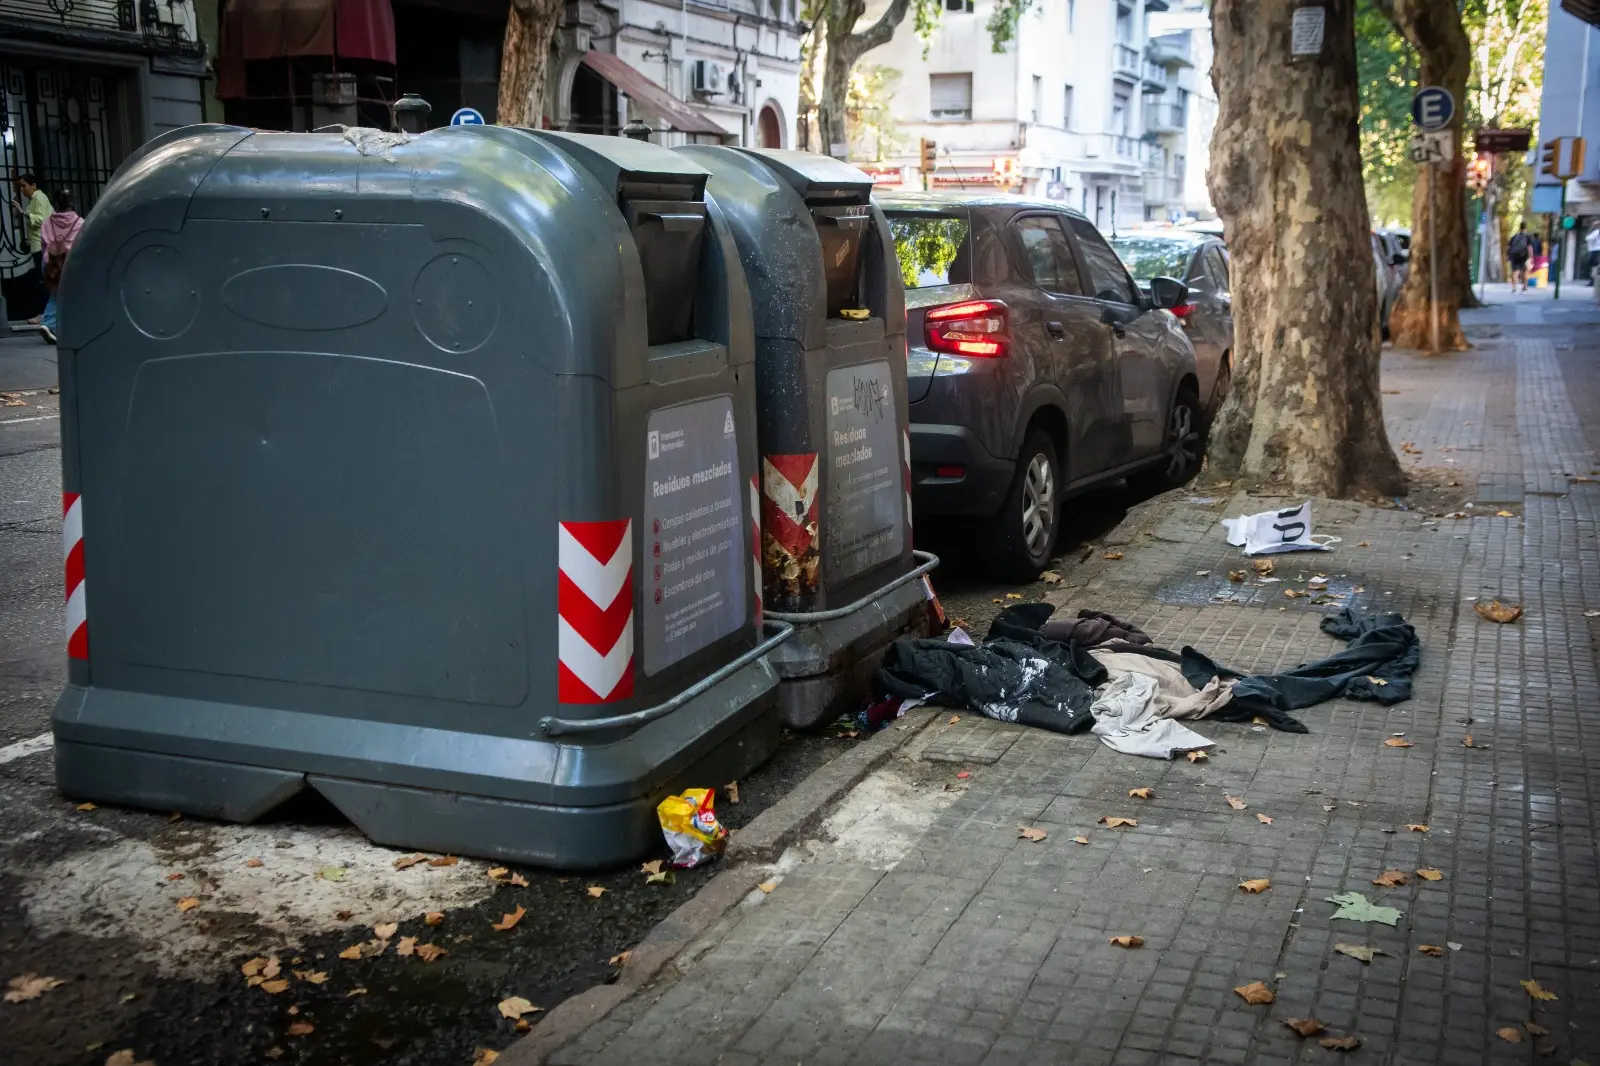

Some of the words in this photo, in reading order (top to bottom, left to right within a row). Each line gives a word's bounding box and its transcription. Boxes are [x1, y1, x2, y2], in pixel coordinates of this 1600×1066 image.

[1421, 94, 1443, 124] E
[834, 427, 867, 447] Residuos
[836, 445, 873, 468] mezclados
[653, 475, 691, 497] Residuos
[692, 461, 732, 485] mezclados
